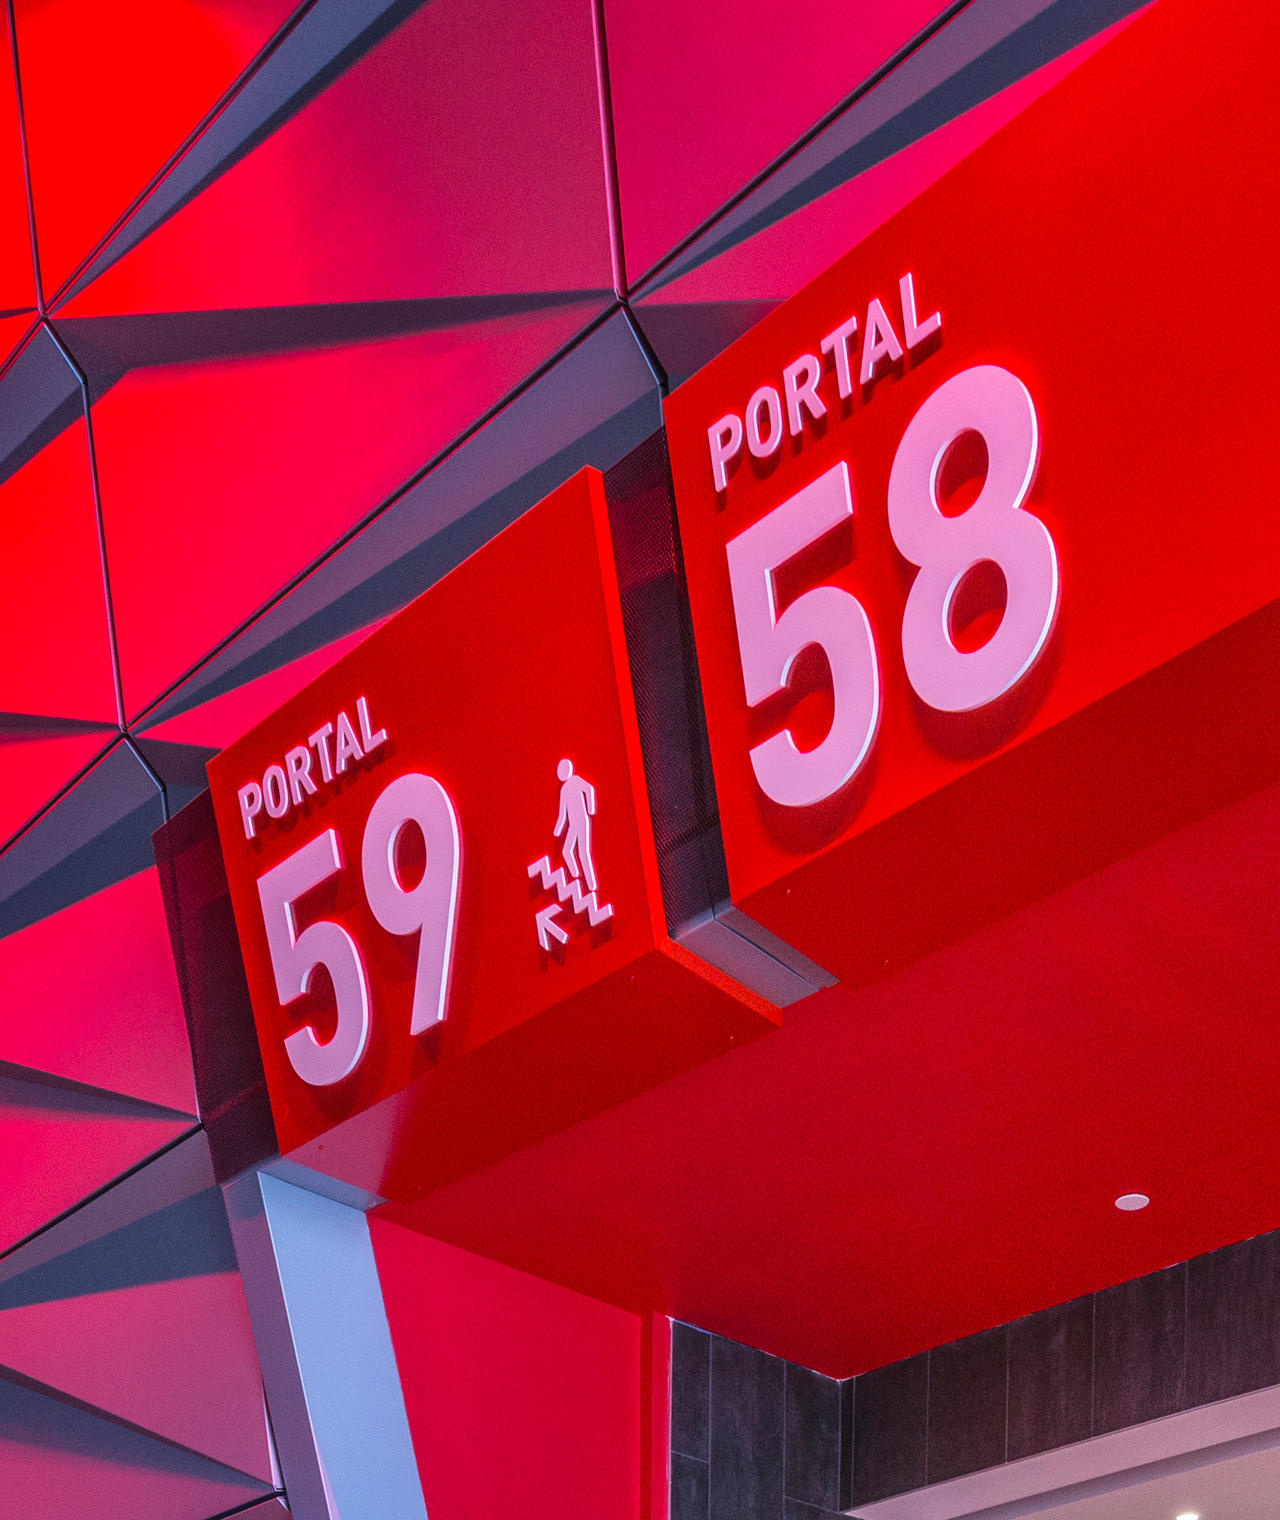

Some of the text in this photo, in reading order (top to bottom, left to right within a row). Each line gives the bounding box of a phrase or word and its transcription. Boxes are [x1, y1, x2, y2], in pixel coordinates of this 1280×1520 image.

[707, 272, 942, 494] PORTAL
[725, 364, 1061, 808] 58
[236, 695, 389, 841] PORTAL
[255, 772, 461, 1087] 59
